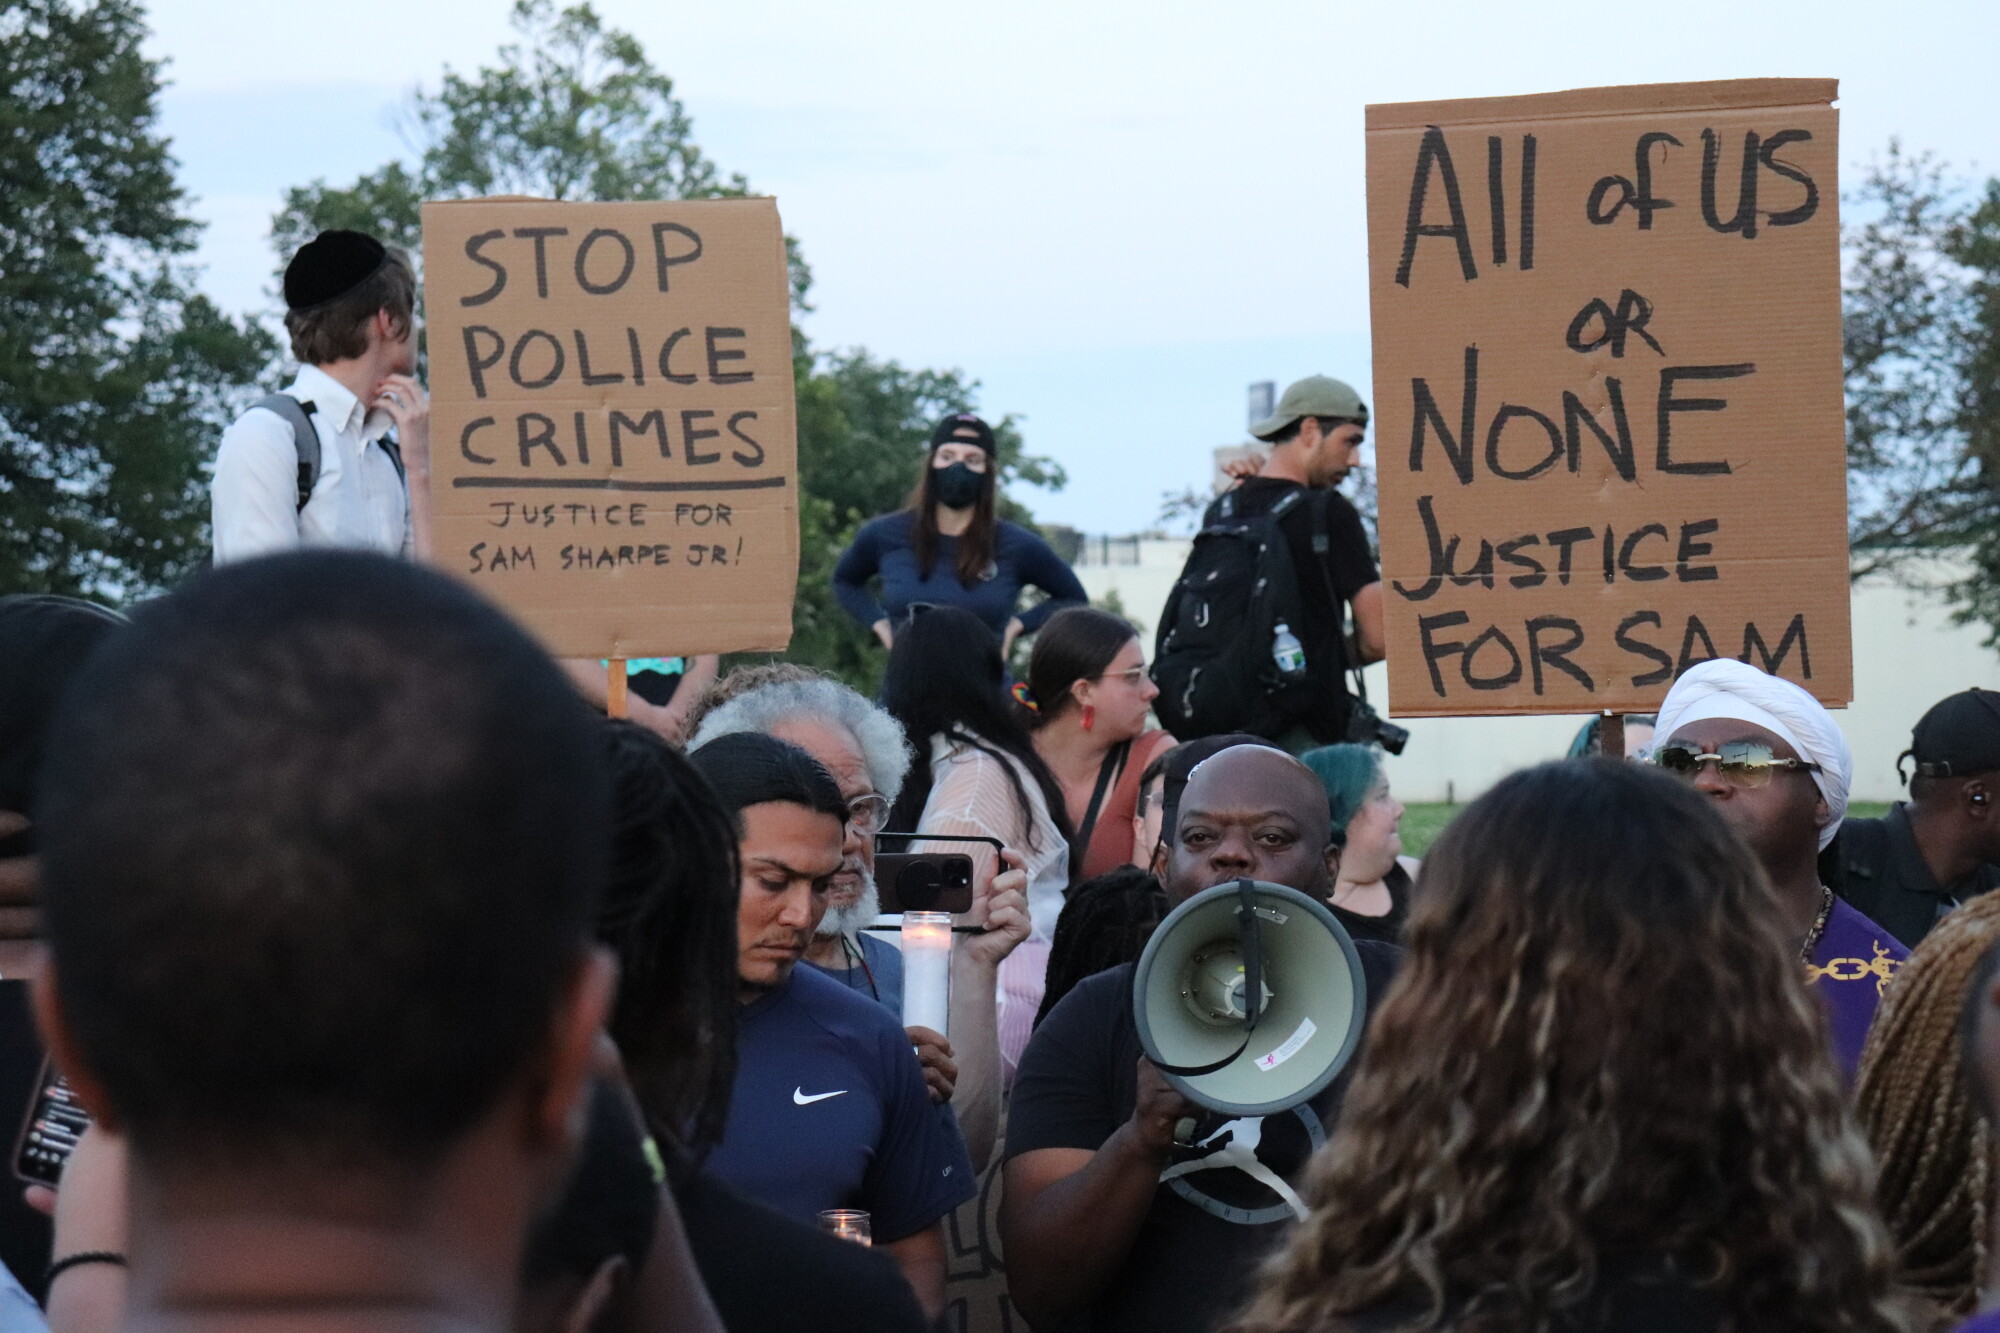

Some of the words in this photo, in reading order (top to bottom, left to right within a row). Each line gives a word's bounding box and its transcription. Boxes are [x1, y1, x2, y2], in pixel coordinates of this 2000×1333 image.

[1395, 125, 1536, 288] All
[1587, 132, 1683, 230] of
[1701, 128, 1819, 239] US
[460, 223, 702, 307] STOP
[1566, 289, 1665, 358] OR
[463, 326, 754, 398] POLICE
[460, 410, 764, 467] CRIMES
[1409, 343, 1755, 485] NONE
[490, 502, 647, 527] JUSTICE
[675, 503, 731, 525] FOR
[470, 542, 535, 573] SAM
[561, 545, 670, 569] SHARPE
[687, 537, 742, 566] JR!
[1419, 611, 1594, 697] FOR
[1615, 611, 1811, 687] SAM
